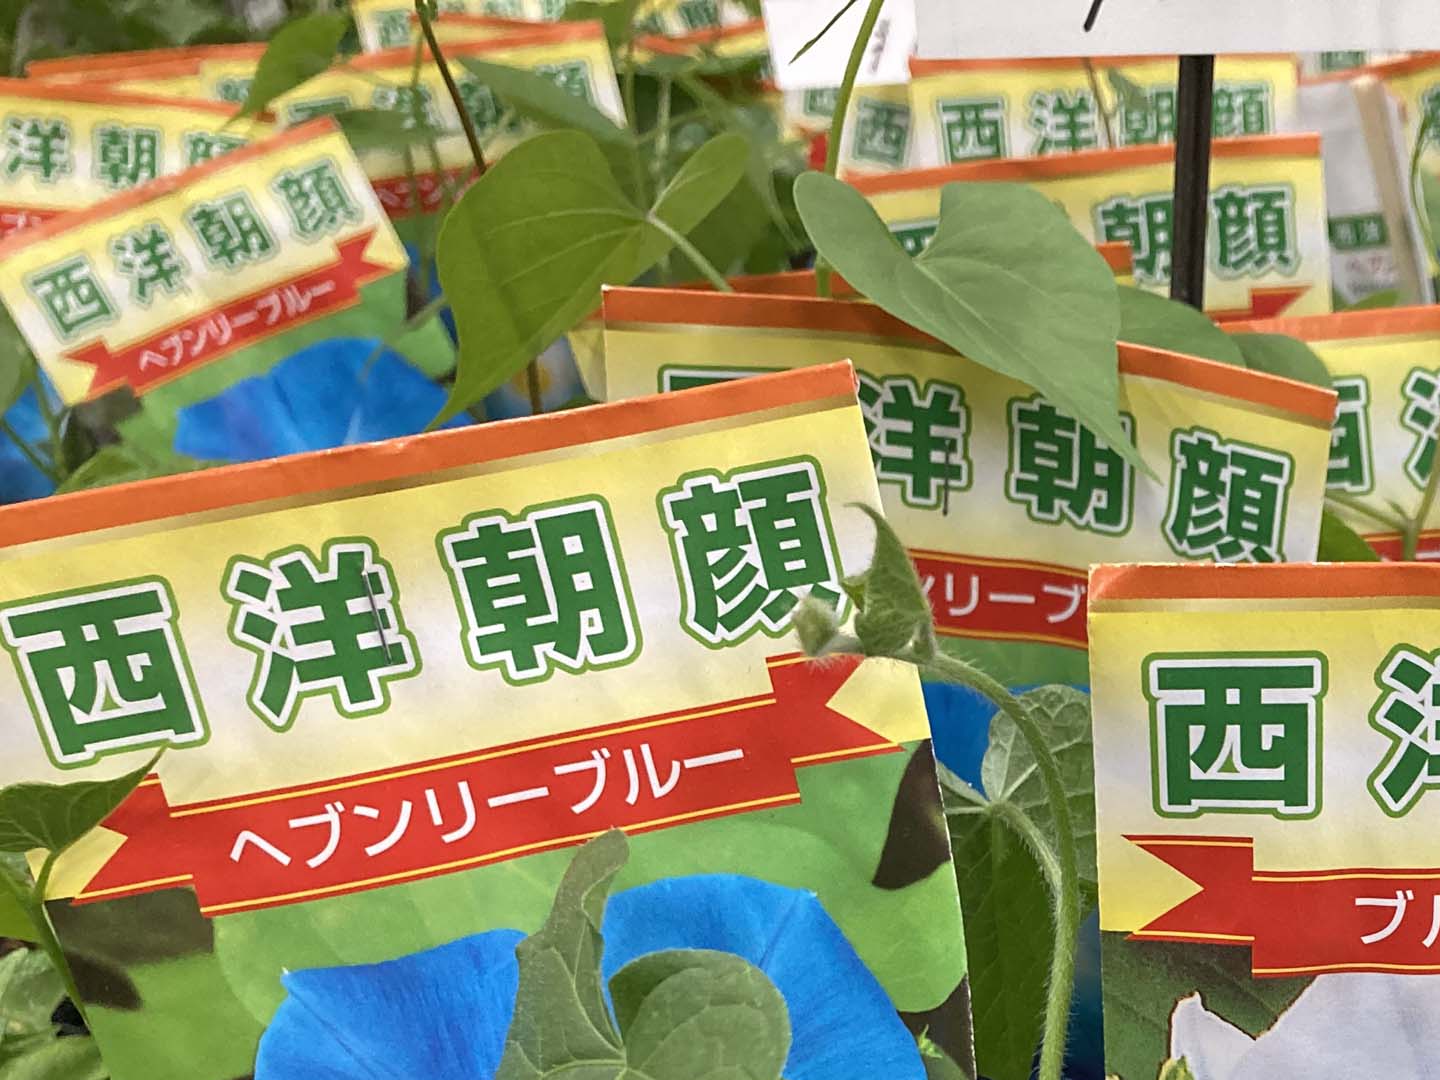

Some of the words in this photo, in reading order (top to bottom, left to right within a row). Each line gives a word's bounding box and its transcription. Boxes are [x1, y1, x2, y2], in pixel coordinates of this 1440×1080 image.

[23, 155, 366, 341] 西洋朝顔
[136, 279, 336, 373] ヘブンリーブルー
[0, 455, 850, 769] 西洋朝顔
[920, 573, 1087, 624] リーブ
[229, 742, 745, 869] ヘブンリーブルー
